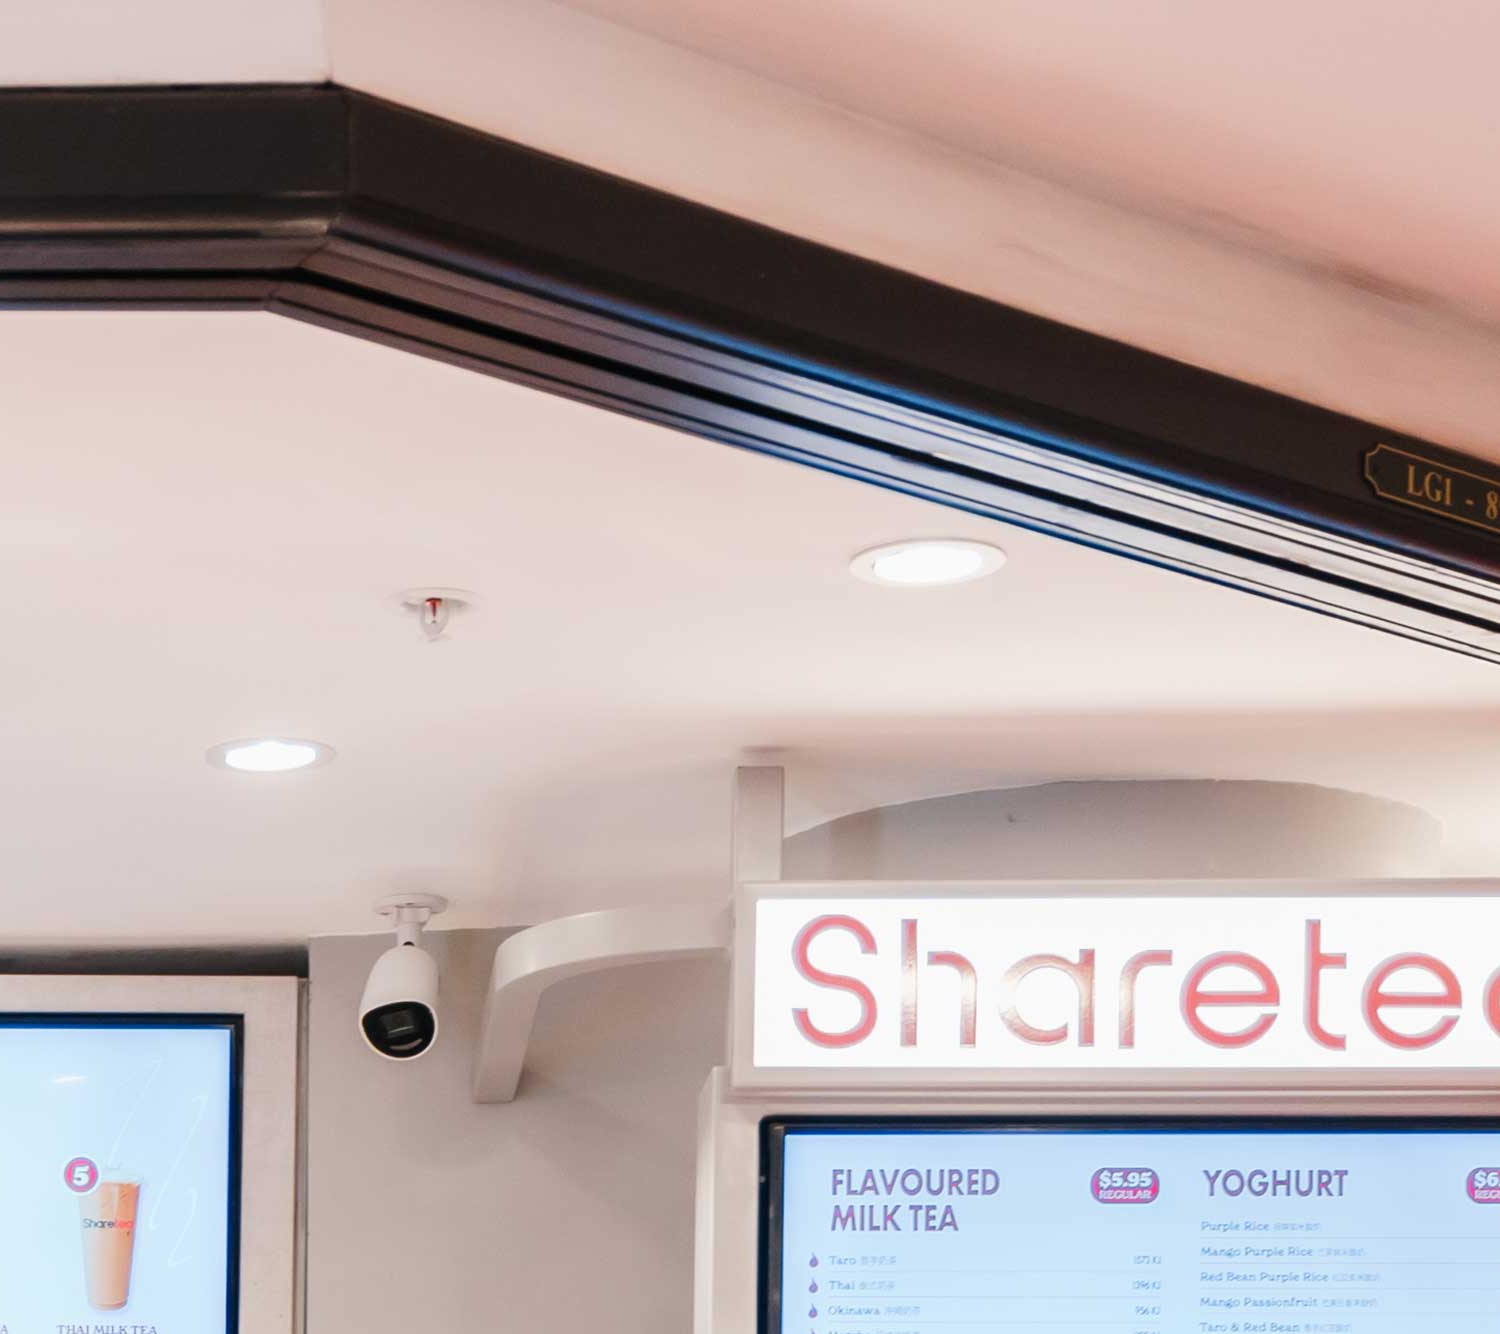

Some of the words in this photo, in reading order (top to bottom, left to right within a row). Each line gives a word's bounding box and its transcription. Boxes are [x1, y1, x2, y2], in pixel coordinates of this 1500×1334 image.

[72, 1166, 89, 1185] 5
[1099, 1170, 1153, 1188] $5.95
[832, 1169, 1000, 1196] FLAVOURED
[1204, 1169, 1348, 1197] YOGHURT
[83, 1217, 133, 1229] Sharetea
[831, 1204, 901, 1232] MILK
[909, 1204, 959, 1232] TEA
[1201, 1222, 1240, 1233] Purple
[1244, 1222, 1270, 1231] Rice
[830, 1256, 857, 1264] Taro
[829, 1281, 855, 1290] Thai
[828, 1306, 880, 1316] Okinawa
[58, 1325, 90, 1334] THAI
[130, 1326, 157, 1334] TEA
